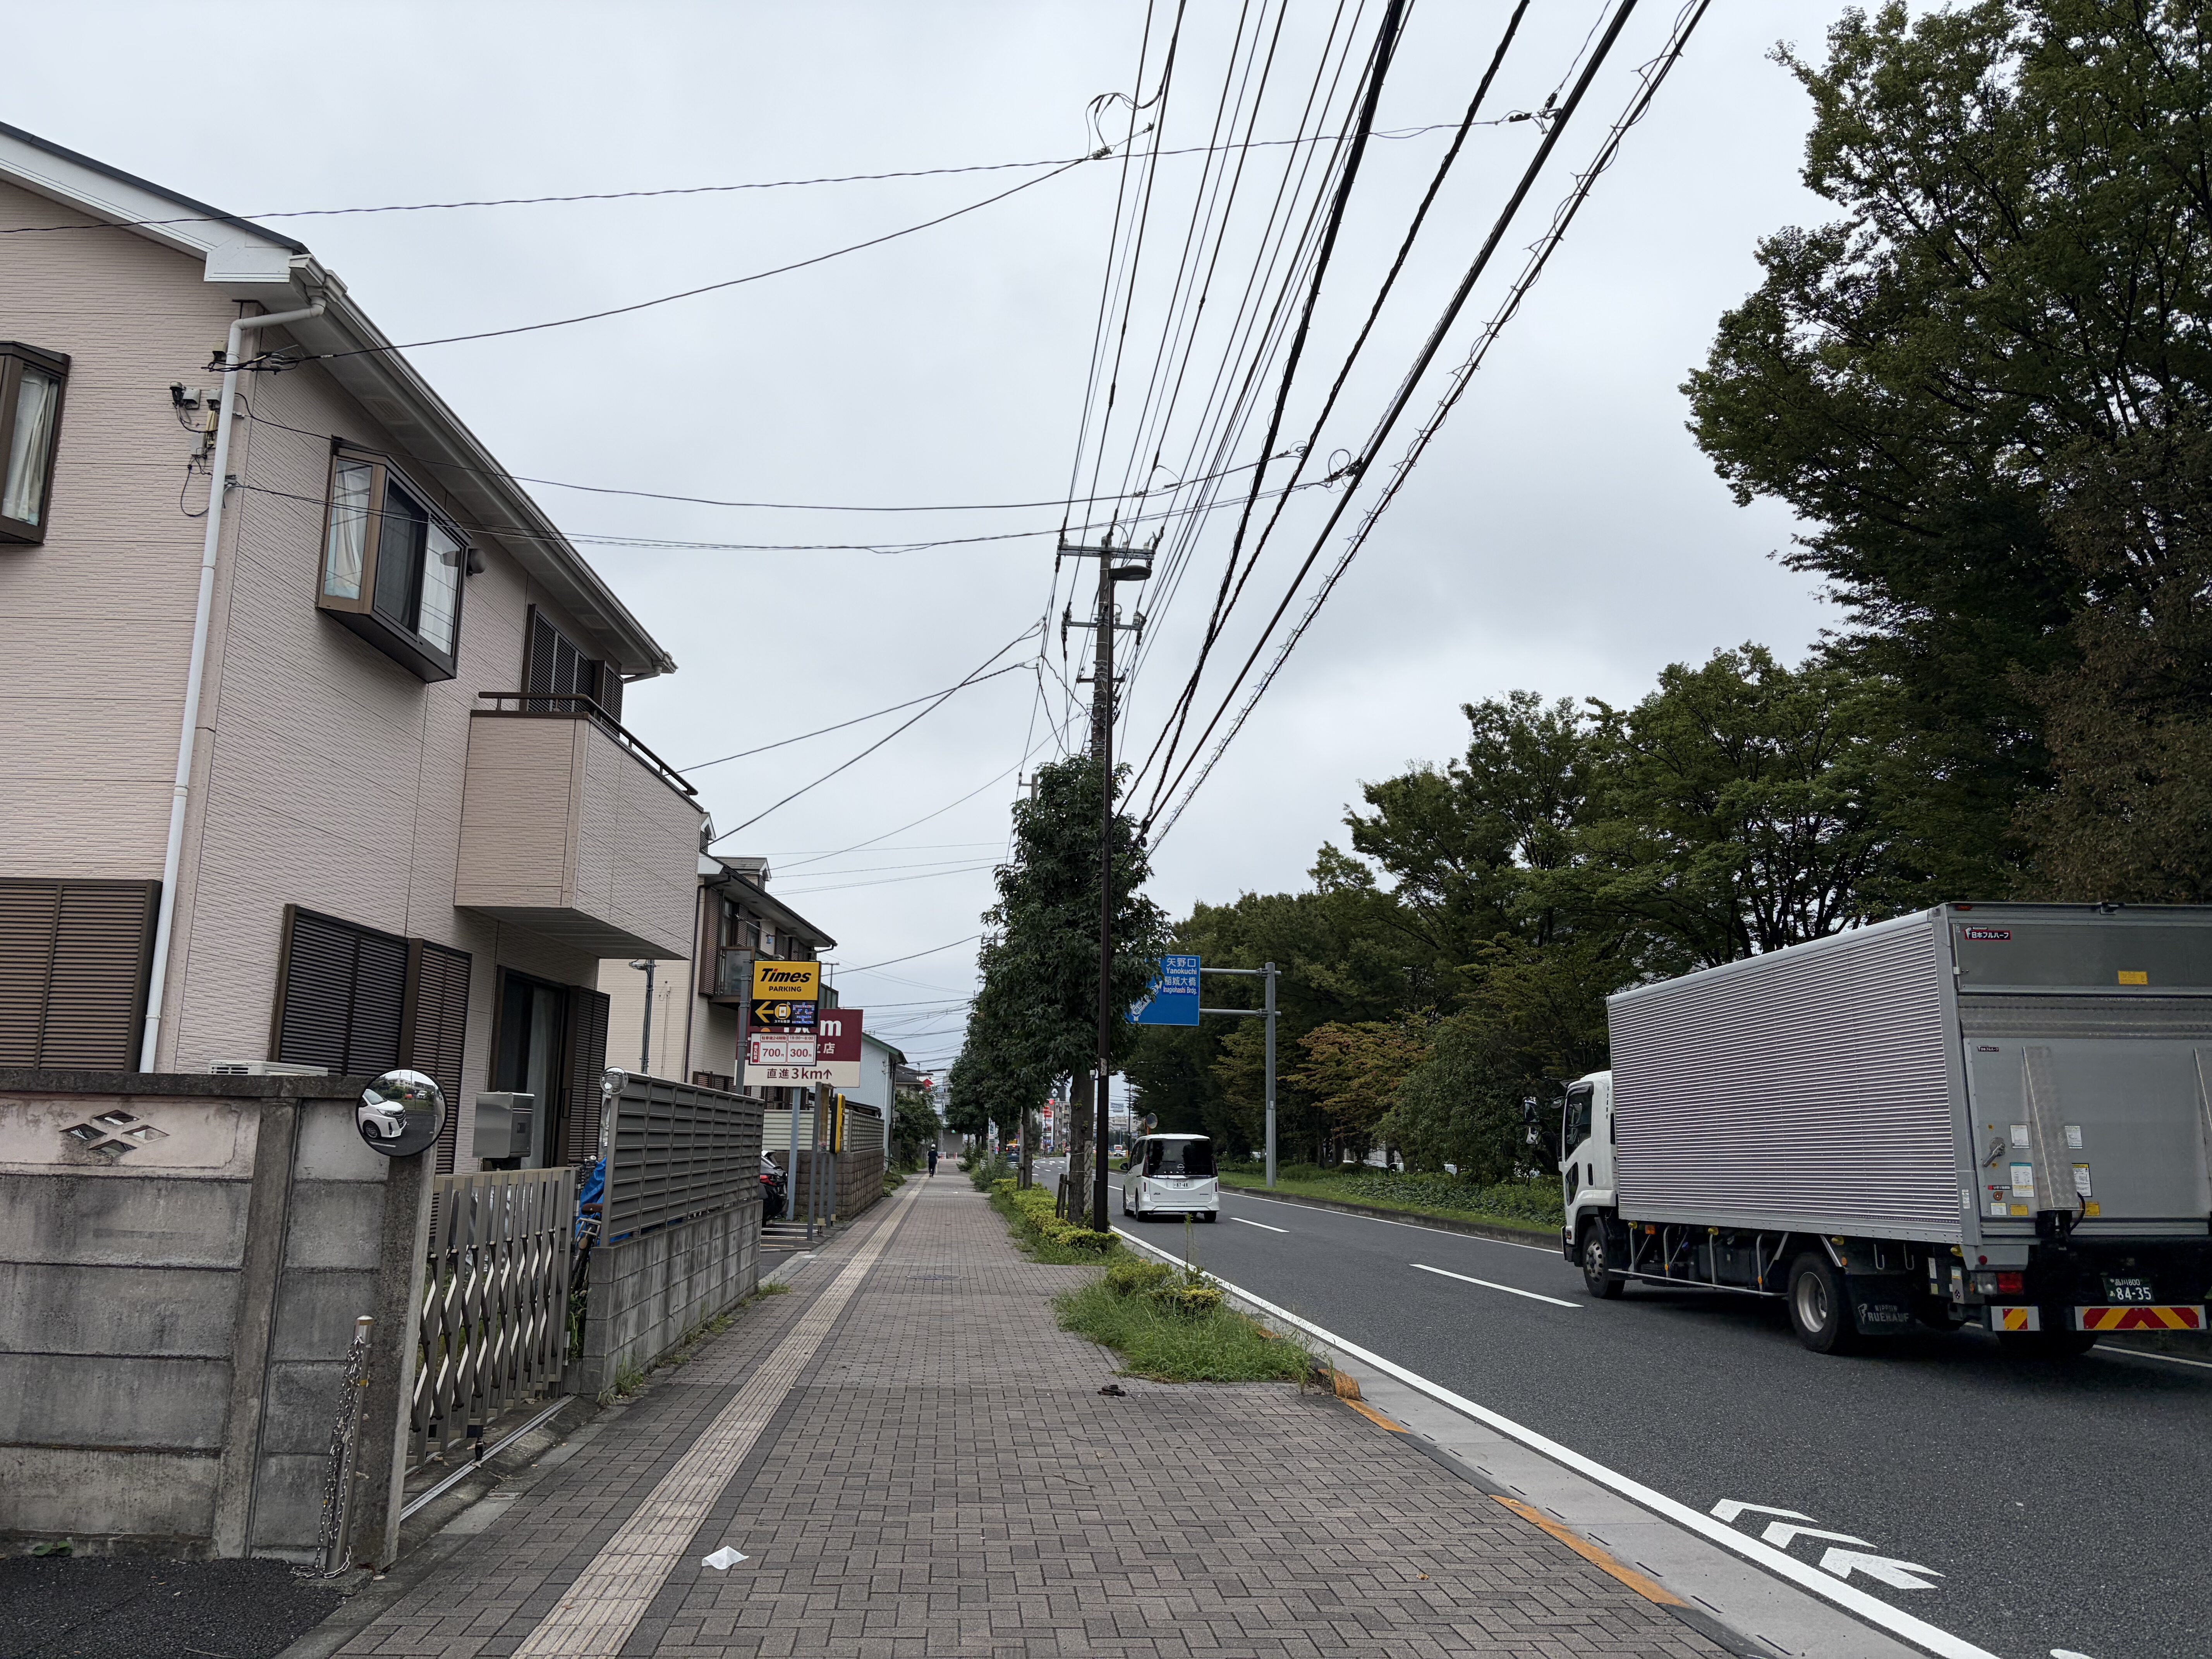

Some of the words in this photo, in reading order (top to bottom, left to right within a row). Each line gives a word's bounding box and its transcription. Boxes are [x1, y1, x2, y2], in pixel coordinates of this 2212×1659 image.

[1166, 957, 1196, 967] 矢野口
[760, 968, 812, 982] Times
[1164, 976, 1196, 986] 稲城大橋
[792, 1002, 814, 1024] 空
[2116, 1287, 2151, 1300] 84-35
